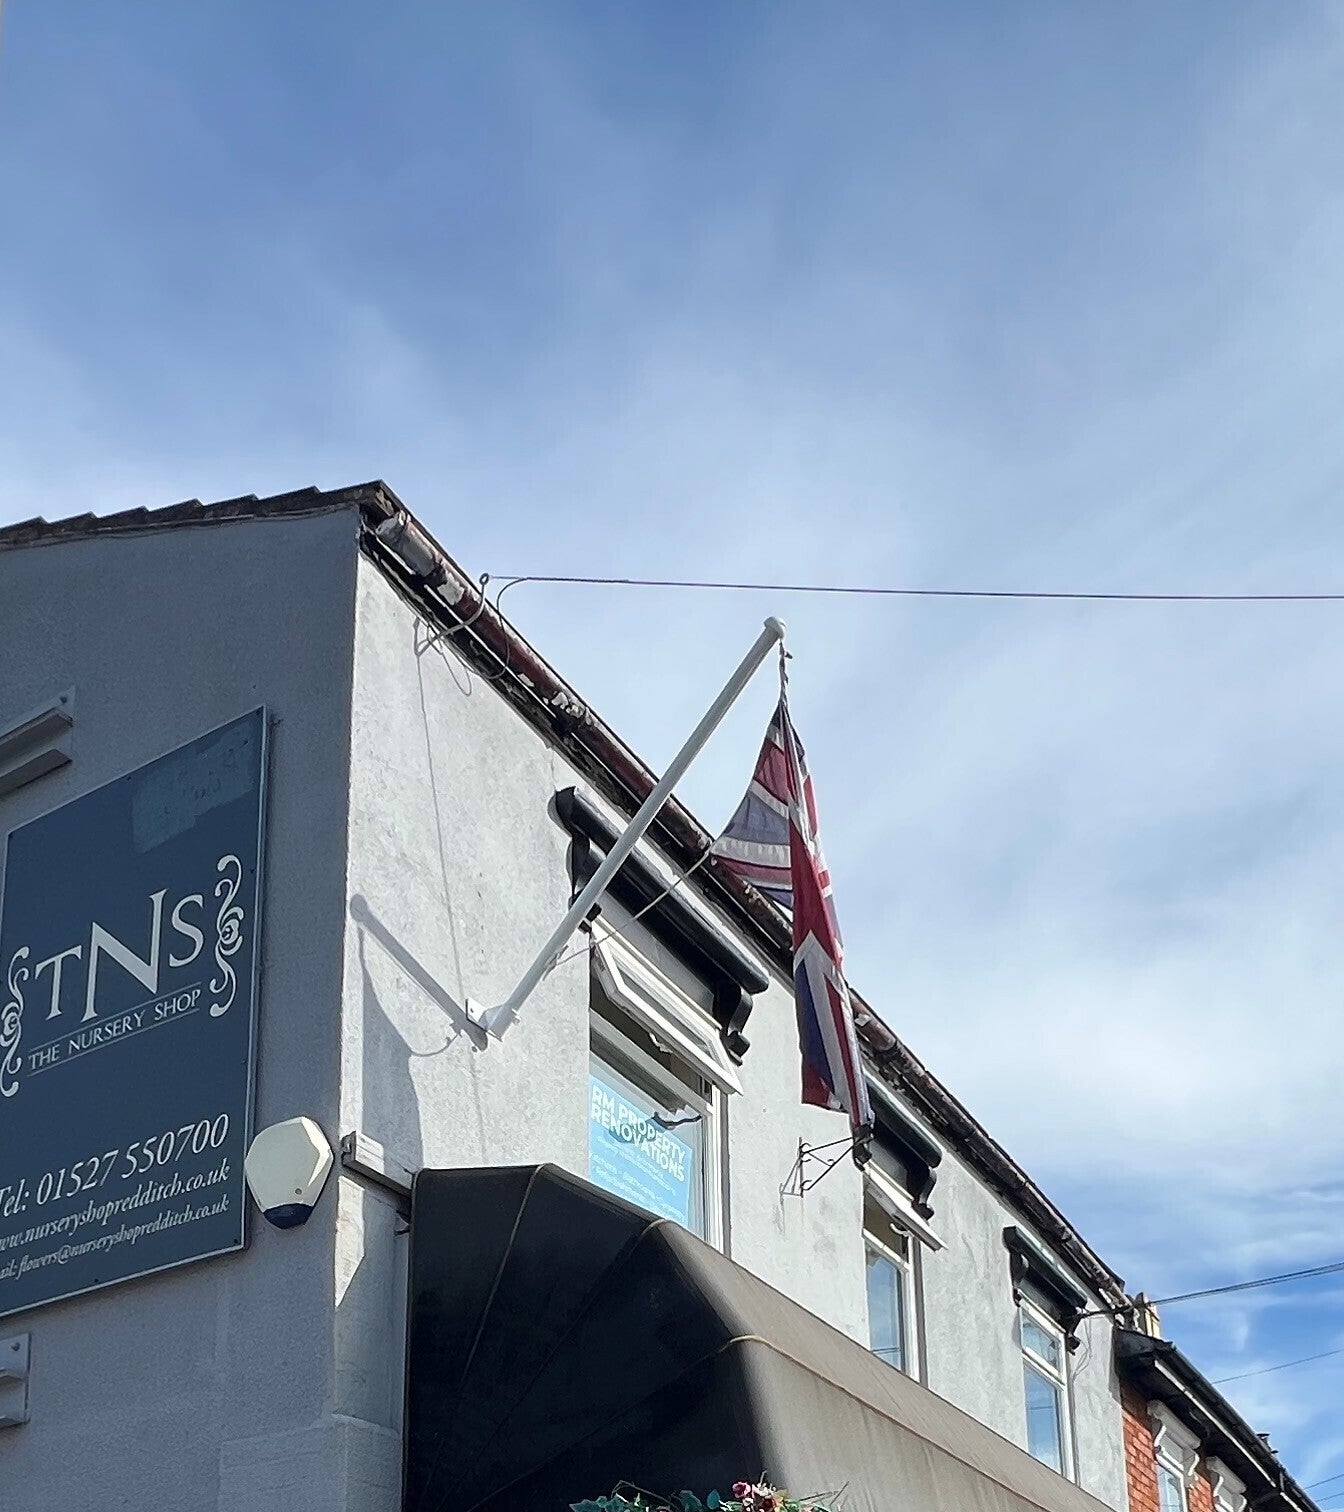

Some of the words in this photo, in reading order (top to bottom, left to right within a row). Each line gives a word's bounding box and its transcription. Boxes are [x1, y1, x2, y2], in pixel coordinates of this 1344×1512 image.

[33, 887, 205, 1022] TNS
[28, 1044, 61, 1071] THE
[68, 1009, 146, 1057] NURSERY
[154, 987, 202, 1022] SHOP
[36, 1149, 119, 1206] 01527
[121, 1113, 230, 1180] 550700
[590, 1102, 685, 1182] RENOVATIONS
[592, 1084, 615, 1116] RM
[618, 1102, 686, 1162] PROPERTY
